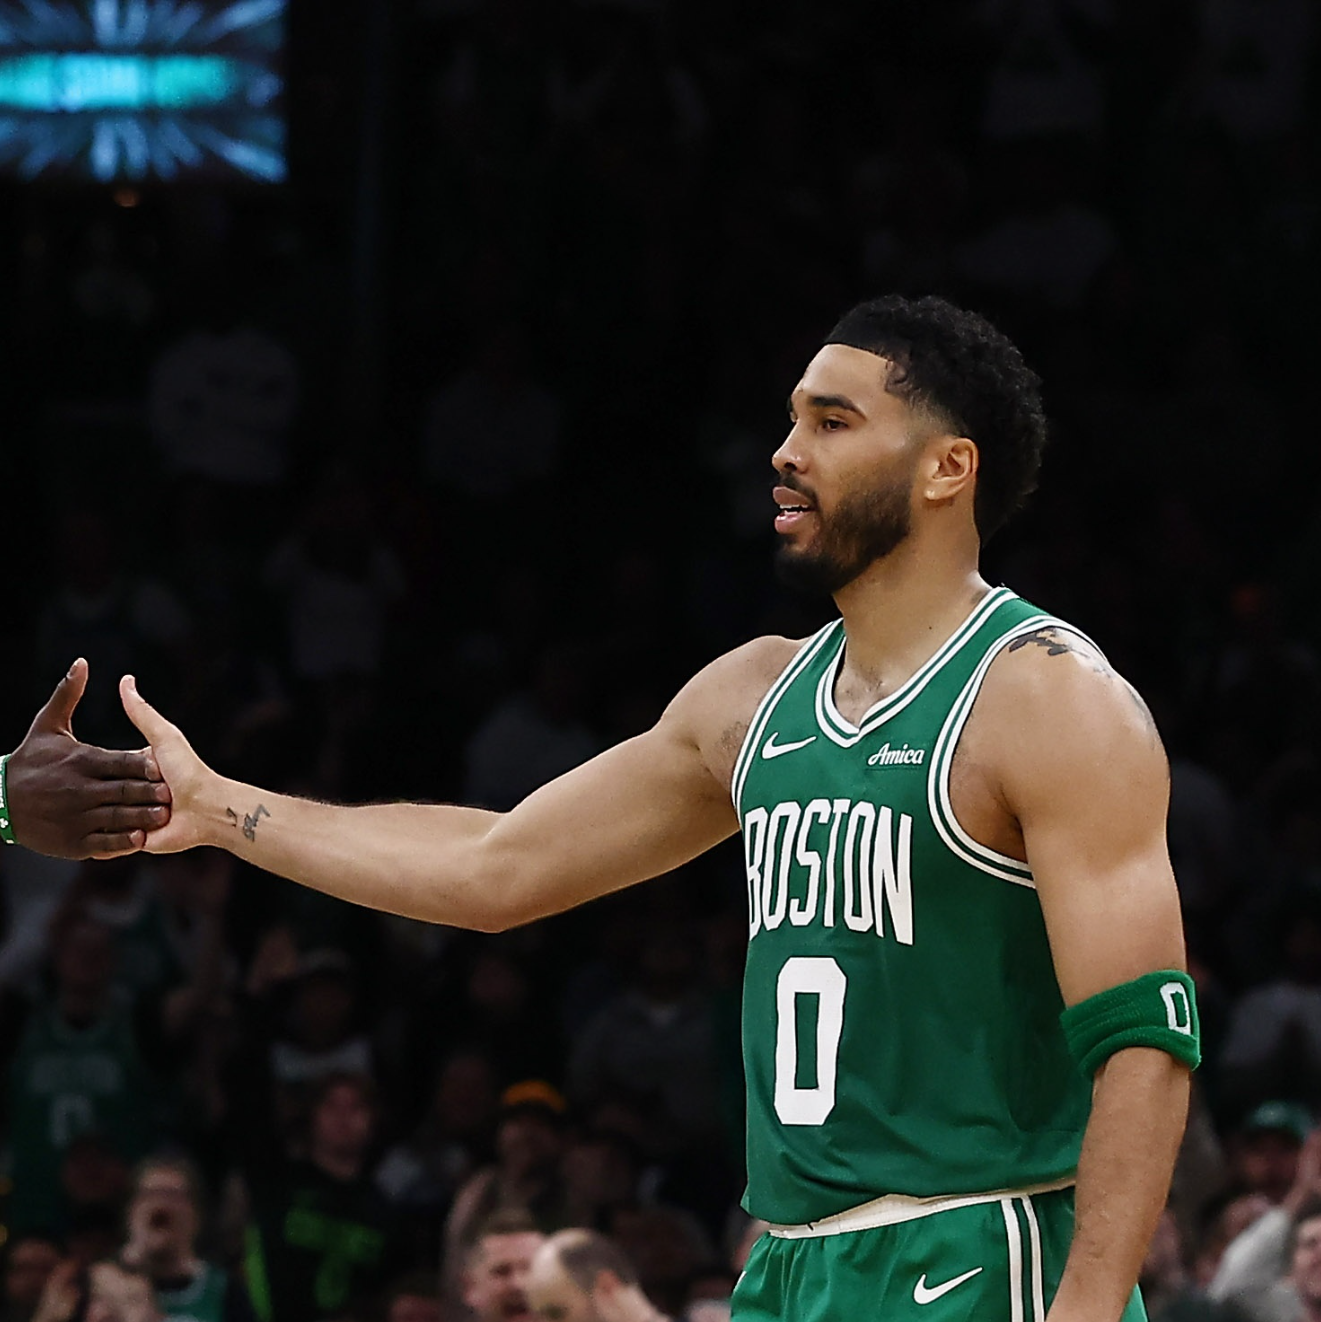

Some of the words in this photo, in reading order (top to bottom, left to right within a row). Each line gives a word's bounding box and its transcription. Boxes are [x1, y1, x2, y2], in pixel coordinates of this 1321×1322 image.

[868, 742, 926, 766] Amica
[744, 797, 914, 946] BOSTON
[774, 957, 848, 1126] 0
